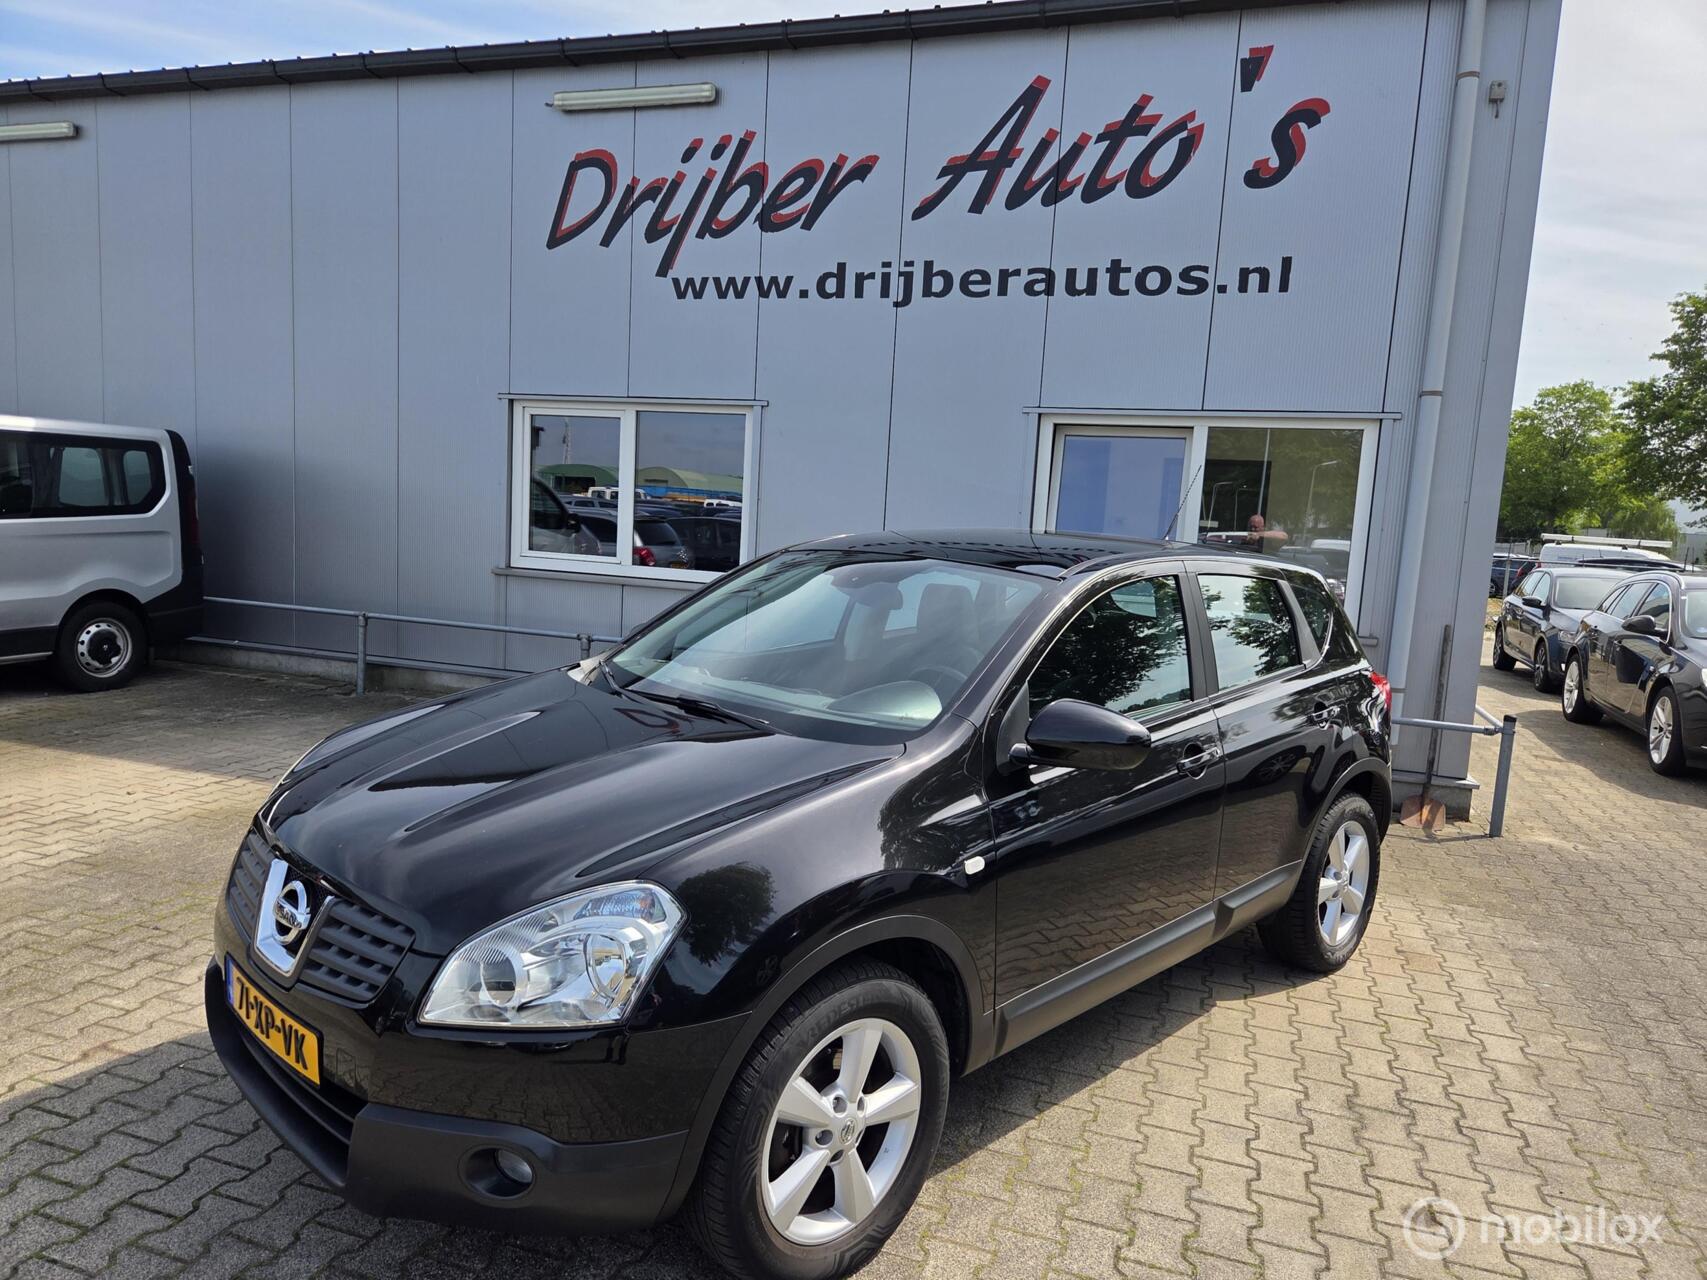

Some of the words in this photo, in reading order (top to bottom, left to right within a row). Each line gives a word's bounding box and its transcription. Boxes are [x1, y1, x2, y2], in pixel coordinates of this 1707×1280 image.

[547, 130, 878, 278] Drijber
[911, 46, 1331, 221] Auto's
[672, 256, 1293, 308] www.drijberautos.nl
[235, 976, 308, 1071] 71-XP-VK
